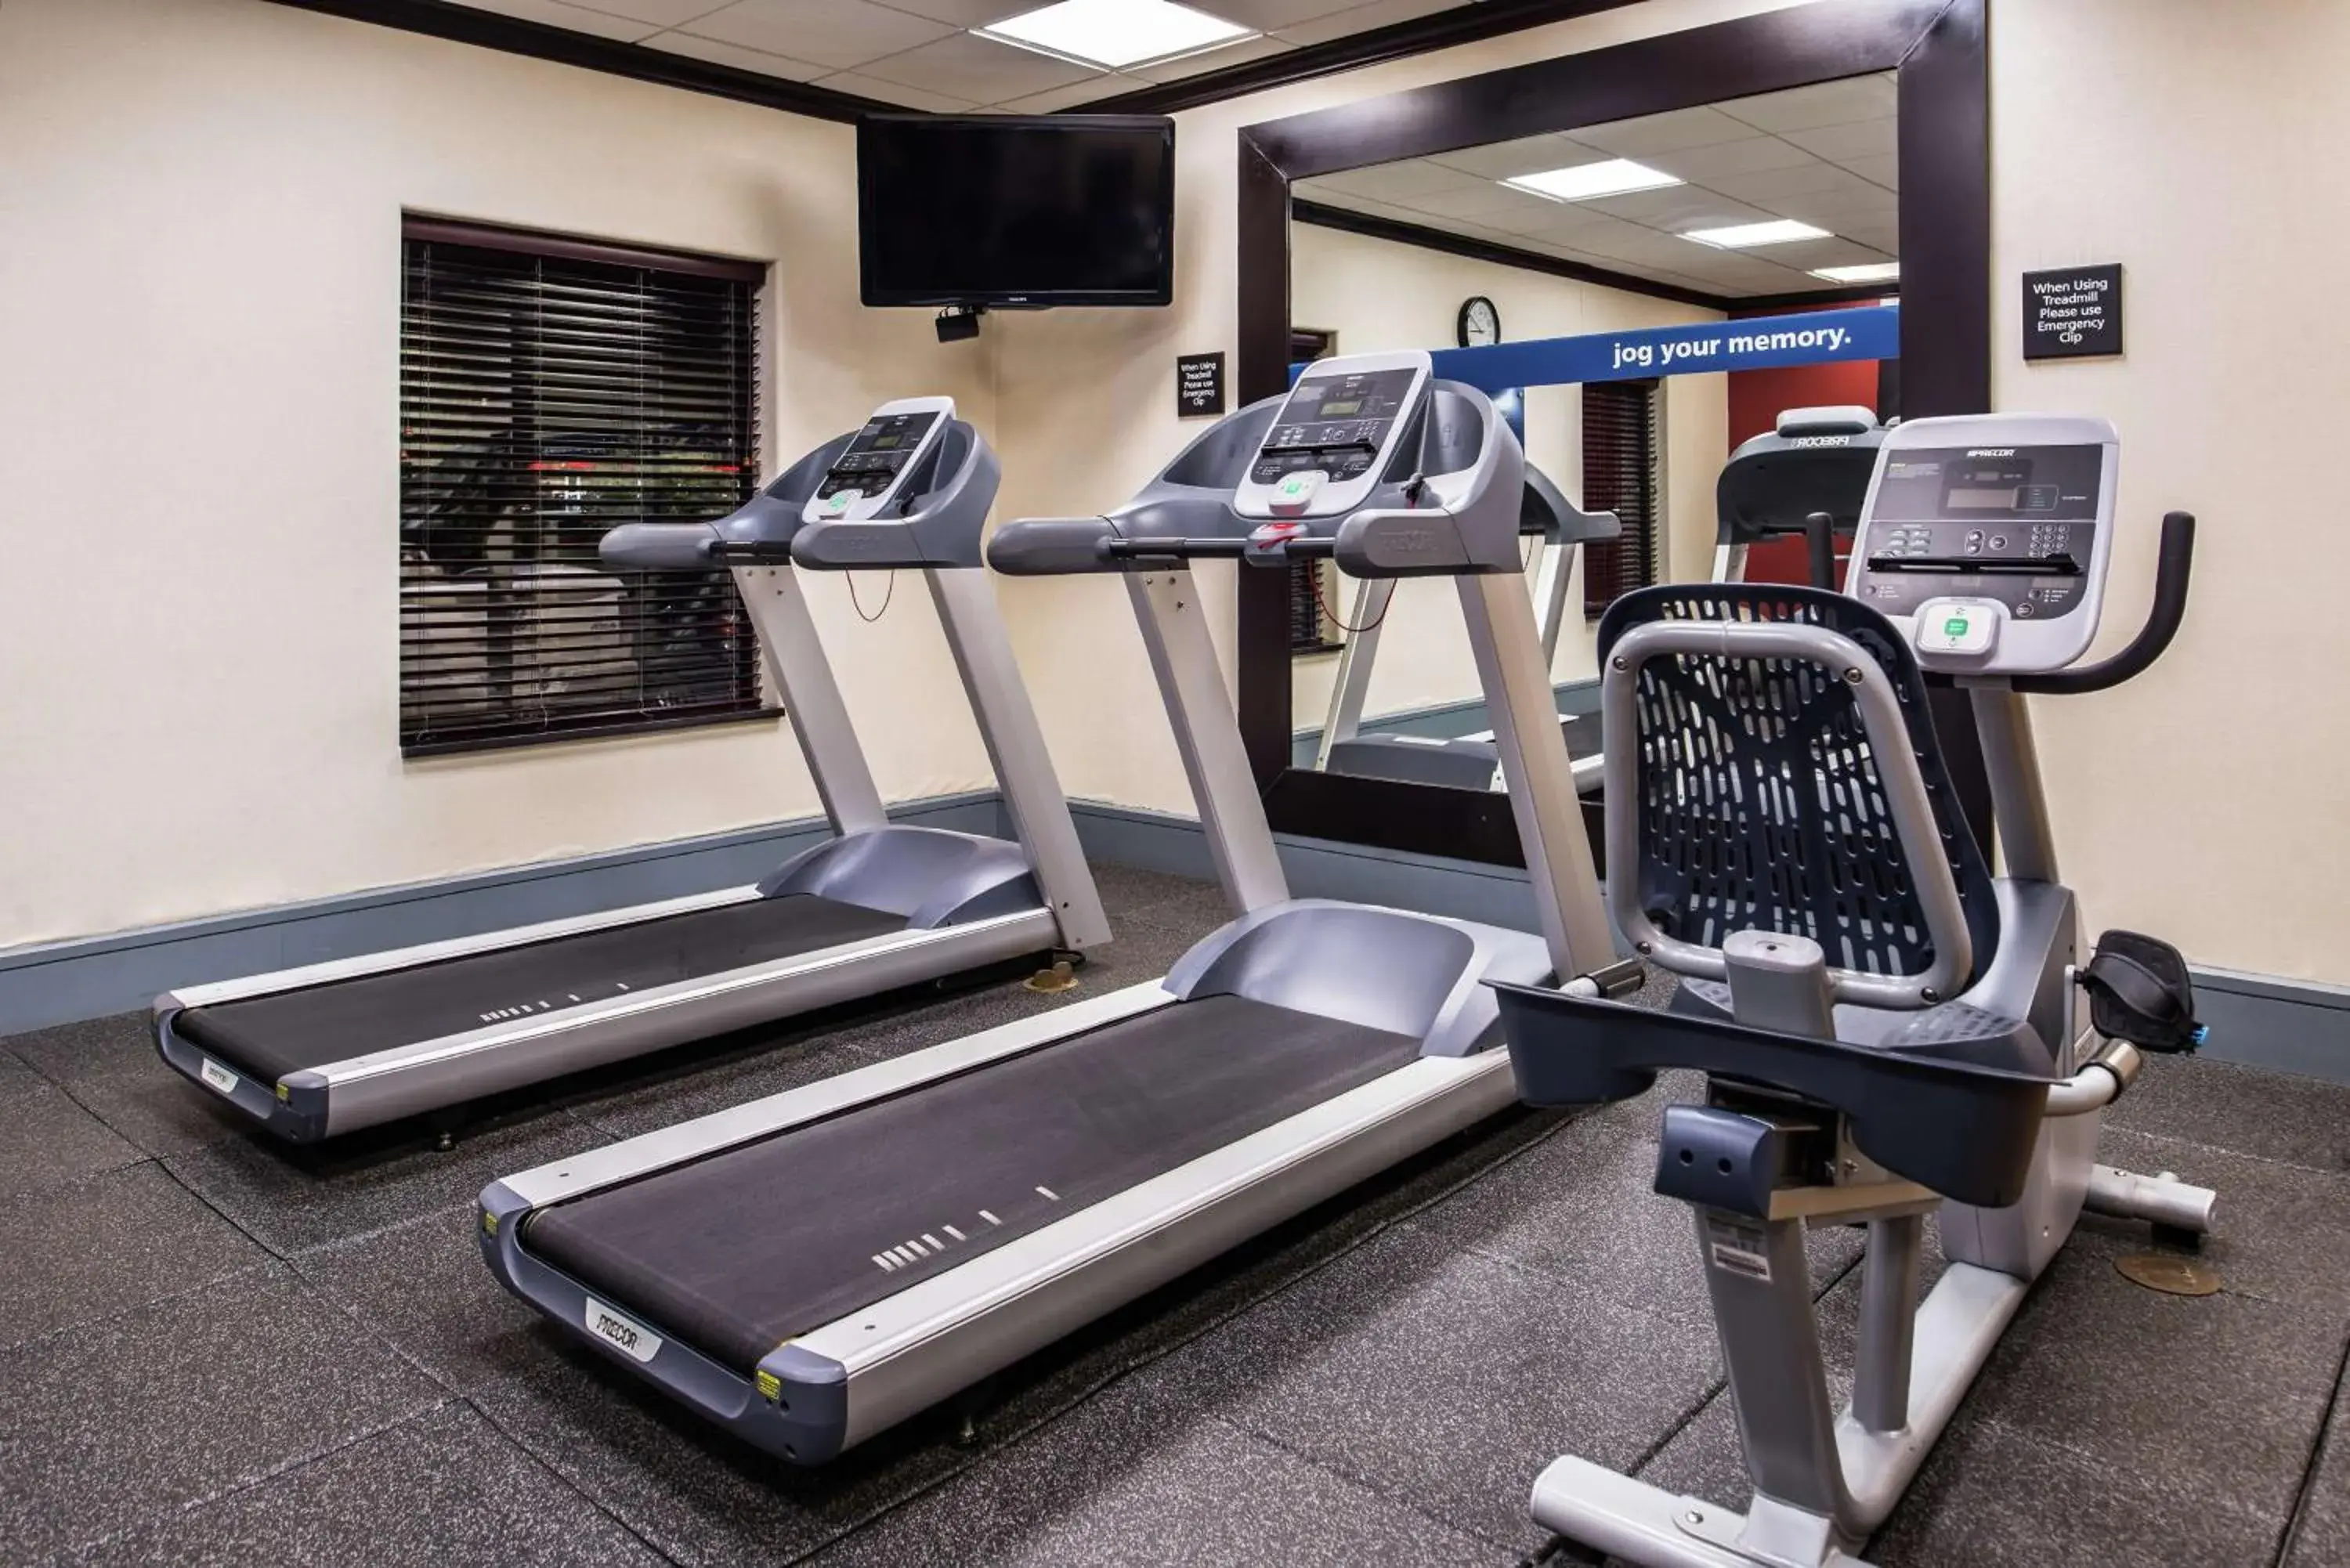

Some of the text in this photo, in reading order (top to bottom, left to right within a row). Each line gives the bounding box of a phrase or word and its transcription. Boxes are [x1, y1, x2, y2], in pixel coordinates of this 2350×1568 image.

[2033, 278, 2109, 294] When Using
[2042, 291, 2099, 306] Treadmill
[2039, 305, 2102, 319] Please use
[2037, 318, 2106, 333] Emergency
[2059, 331, 2084, 345] Clip
[1612, 327, 1852, 369] jog your memory.
[596, 1313, 638, 1350] PRECOR
